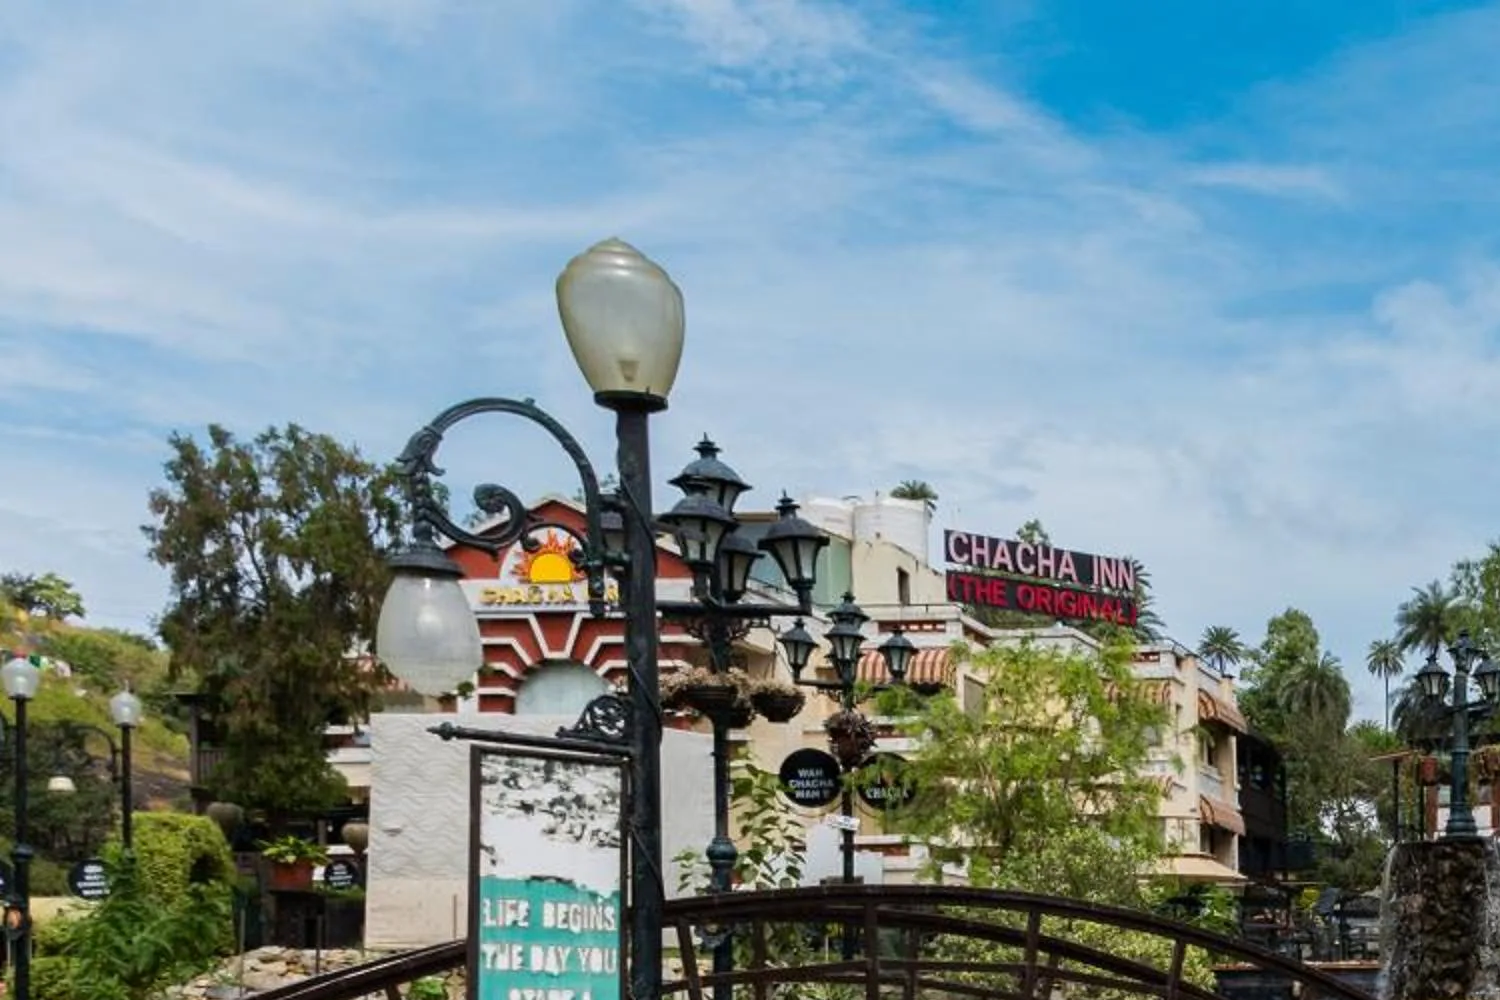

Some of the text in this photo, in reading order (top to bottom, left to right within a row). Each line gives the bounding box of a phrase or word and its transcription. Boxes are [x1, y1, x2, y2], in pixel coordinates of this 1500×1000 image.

[948, 531, 1135, 590] CHACHA INN
[948, 574, 1009, 607] (THE
[483, 898, 617, 934] LIFE BEGINS
[481, 943, 617, 975] THE DAY YOU
